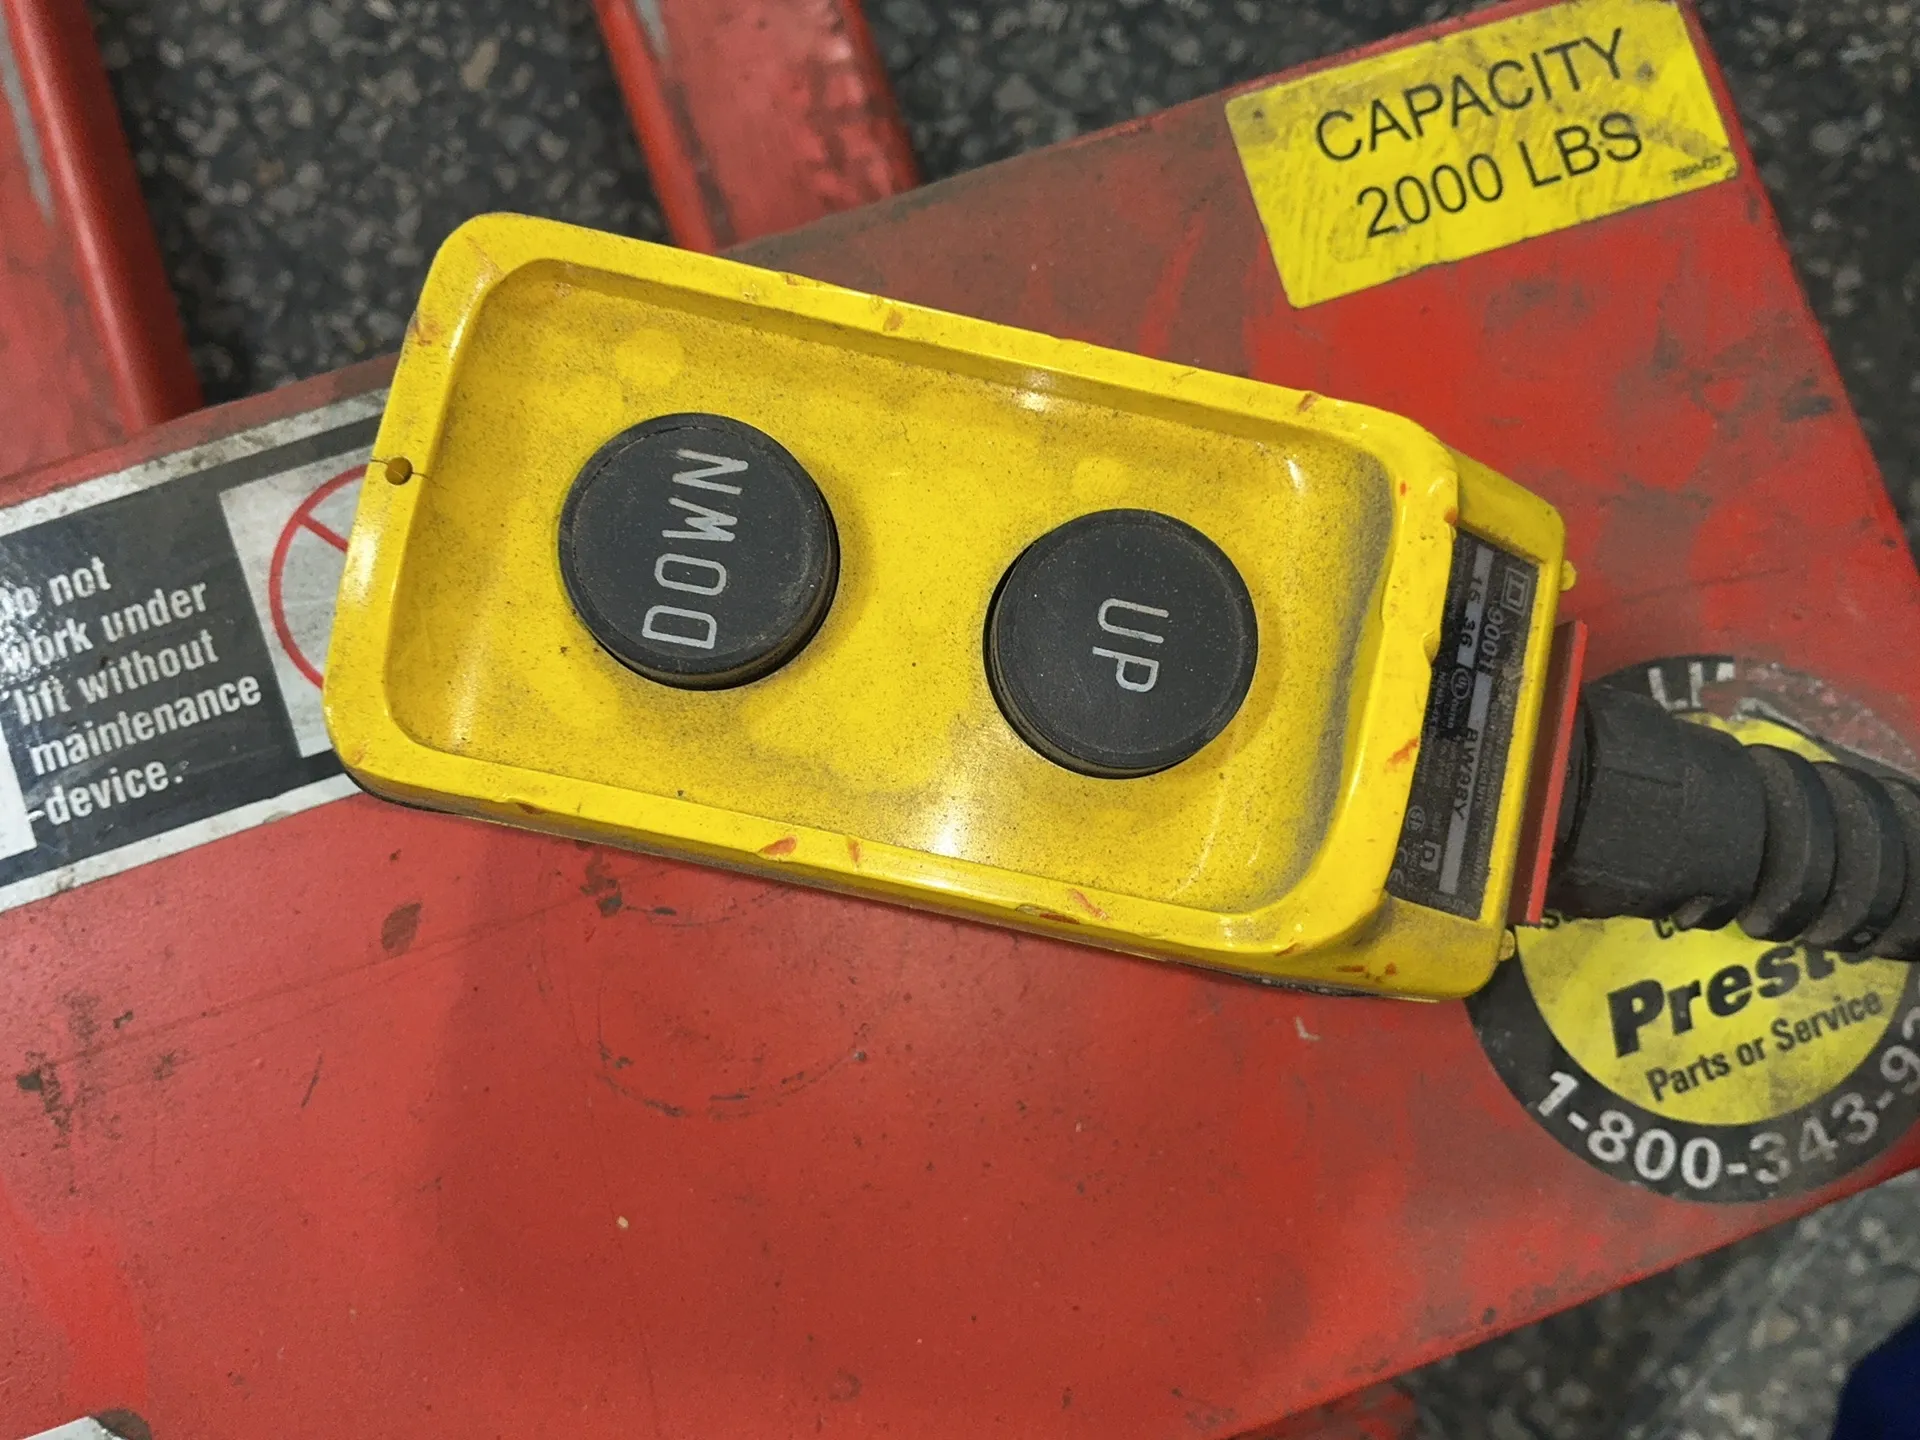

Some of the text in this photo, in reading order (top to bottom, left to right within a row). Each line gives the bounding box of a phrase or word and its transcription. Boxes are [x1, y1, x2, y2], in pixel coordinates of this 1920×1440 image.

[1316, 27, 1624, 162] CAPACITY
[1356, 112, 1644, 239] 2000 LBS
[49, 556, 112, 606] not
[642, 448, 749, 650] DOWN
[0, 581, 208, 673] work under
[13, 628, 219, 727] lift without
[1091, 598, 1170, 692] UP
[30, 675, 262, 777] maintenance
[1646, 991, 1883, 1102] Parts or Service
